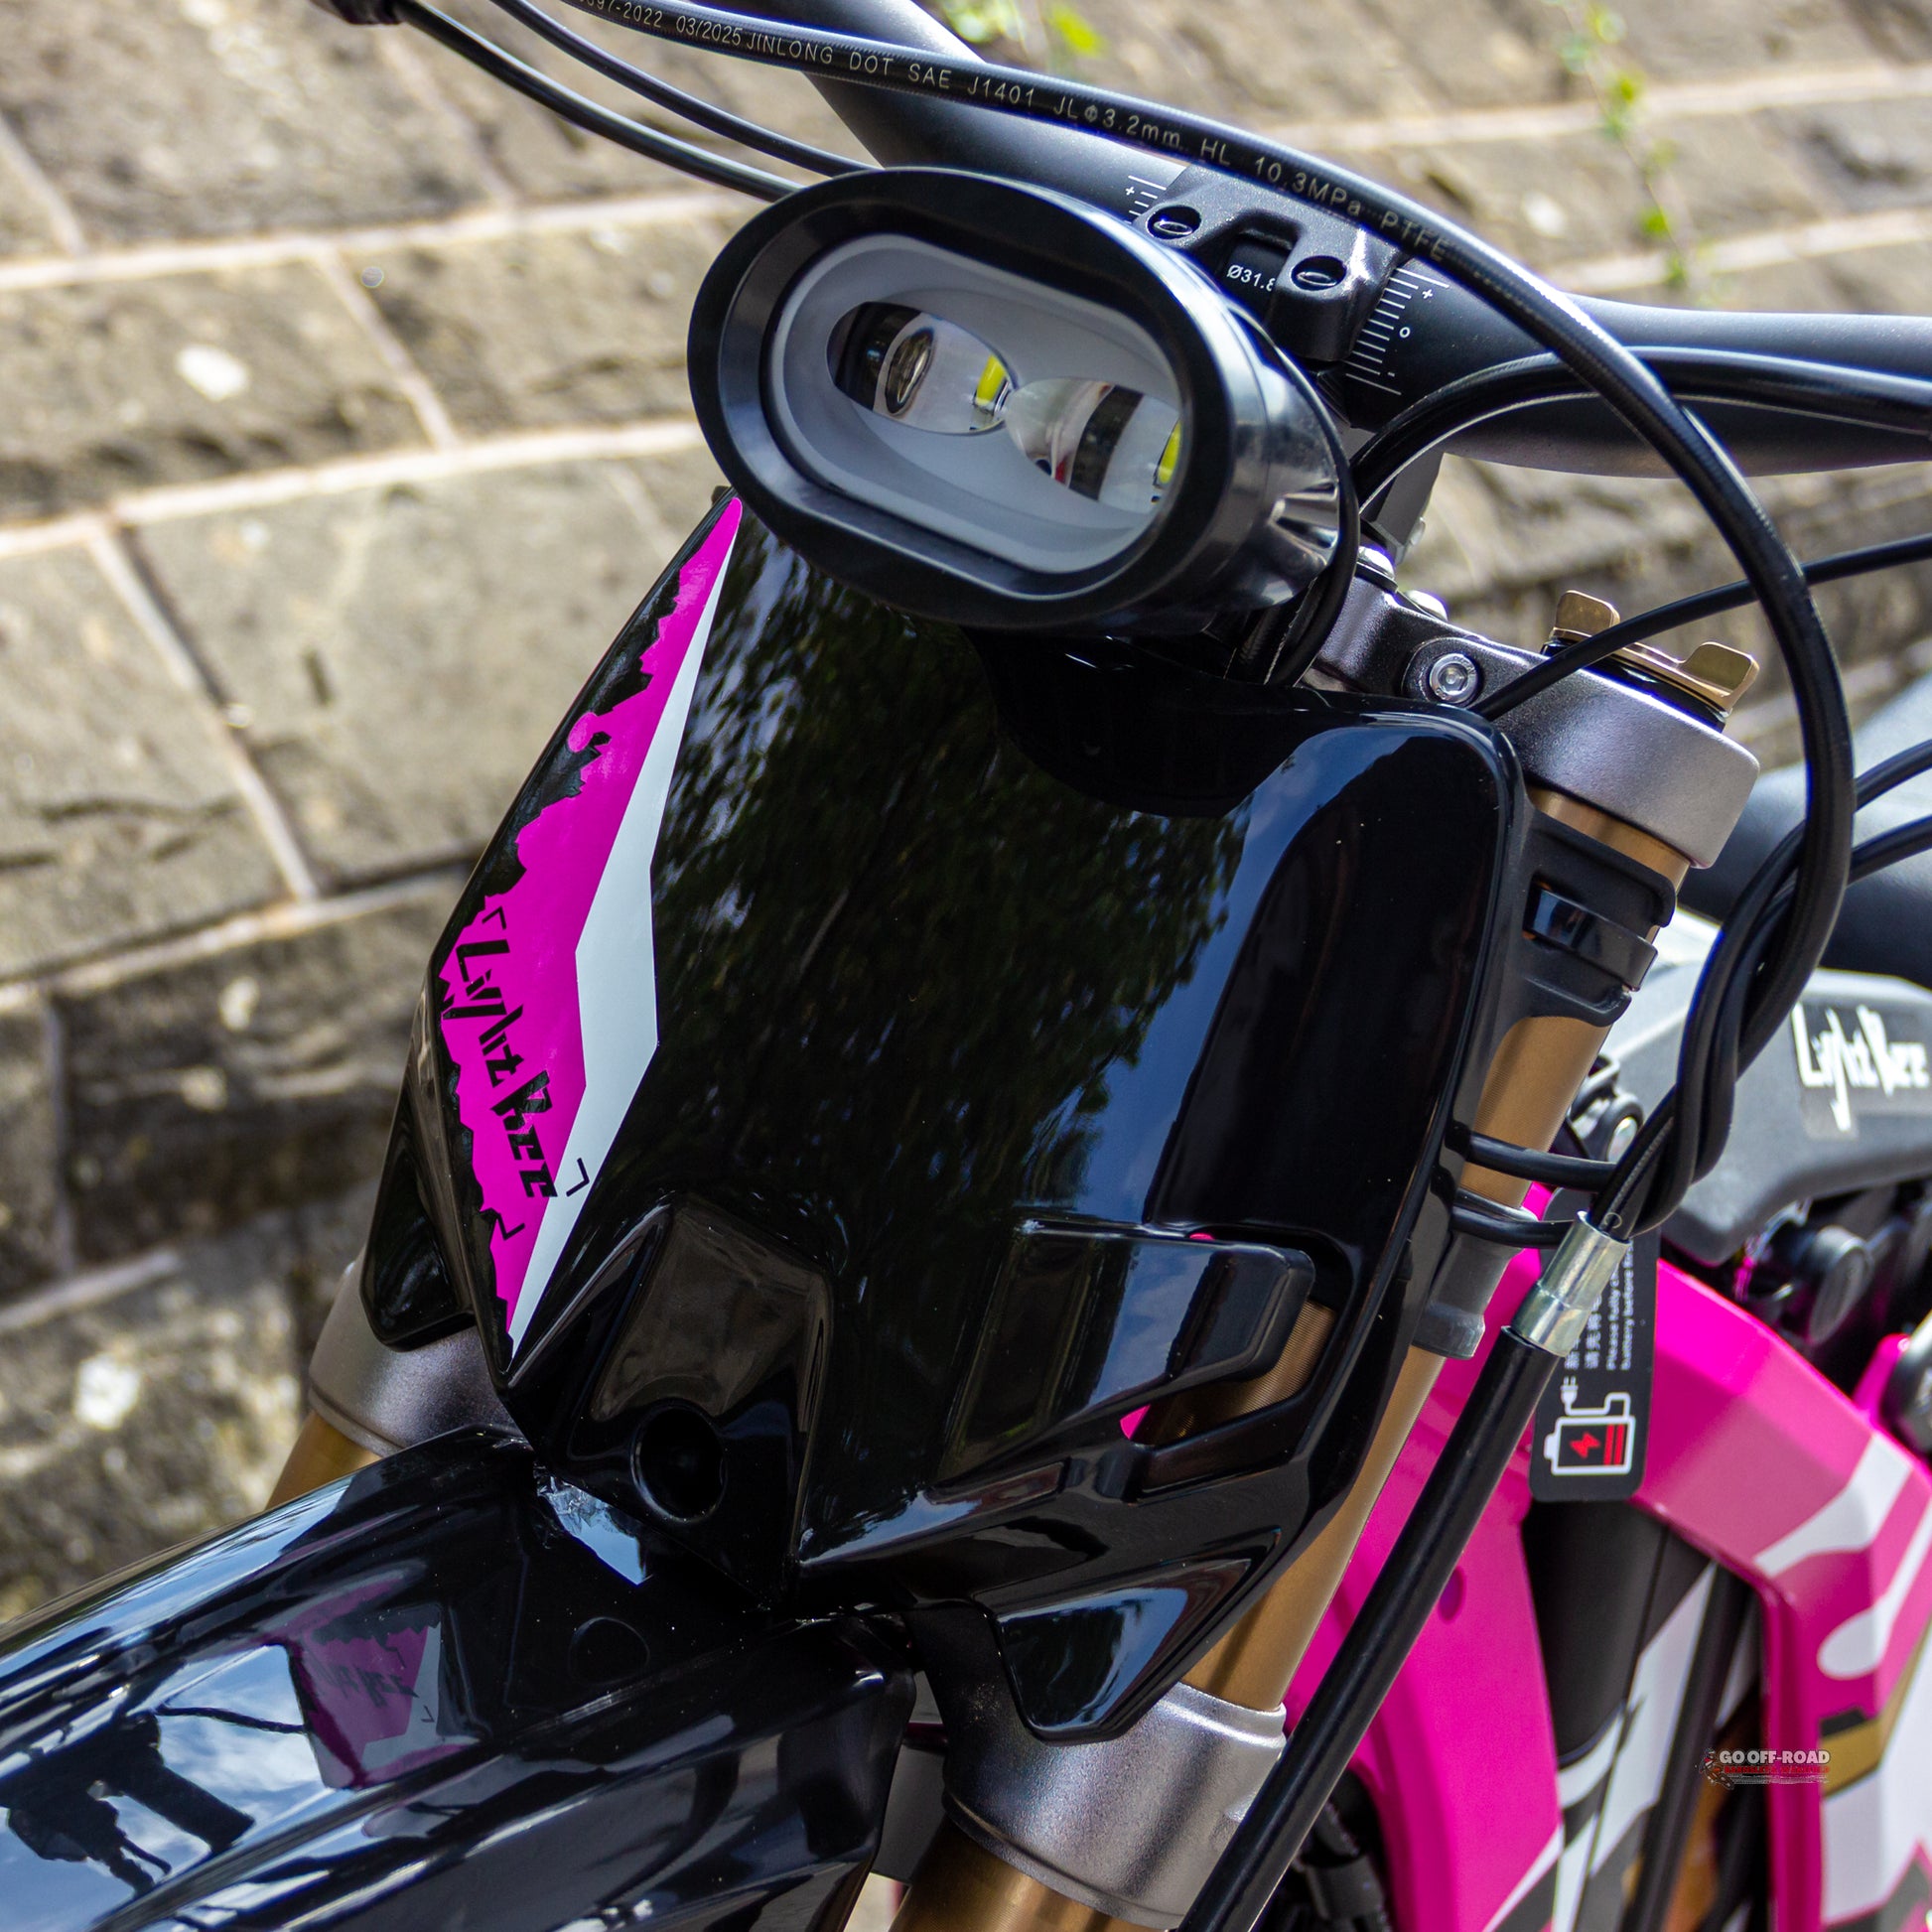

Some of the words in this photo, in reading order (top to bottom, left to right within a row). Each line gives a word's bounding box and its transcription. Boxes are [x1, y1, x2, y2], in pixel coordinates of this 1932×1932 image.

[676, 15, 743, 46] 03/2025
[747, 33, 833, 65] JINLONG
[849, 51, 894, 75] DOT
[907, 63, 952, 89] SAE
[967, 76, 1035, 107] J1401
[1200, 138, 1230, 166] HL
[1255, 157, 1360, 216] 10.3MPa
[1380, 210, 1451, 261] PTFE
